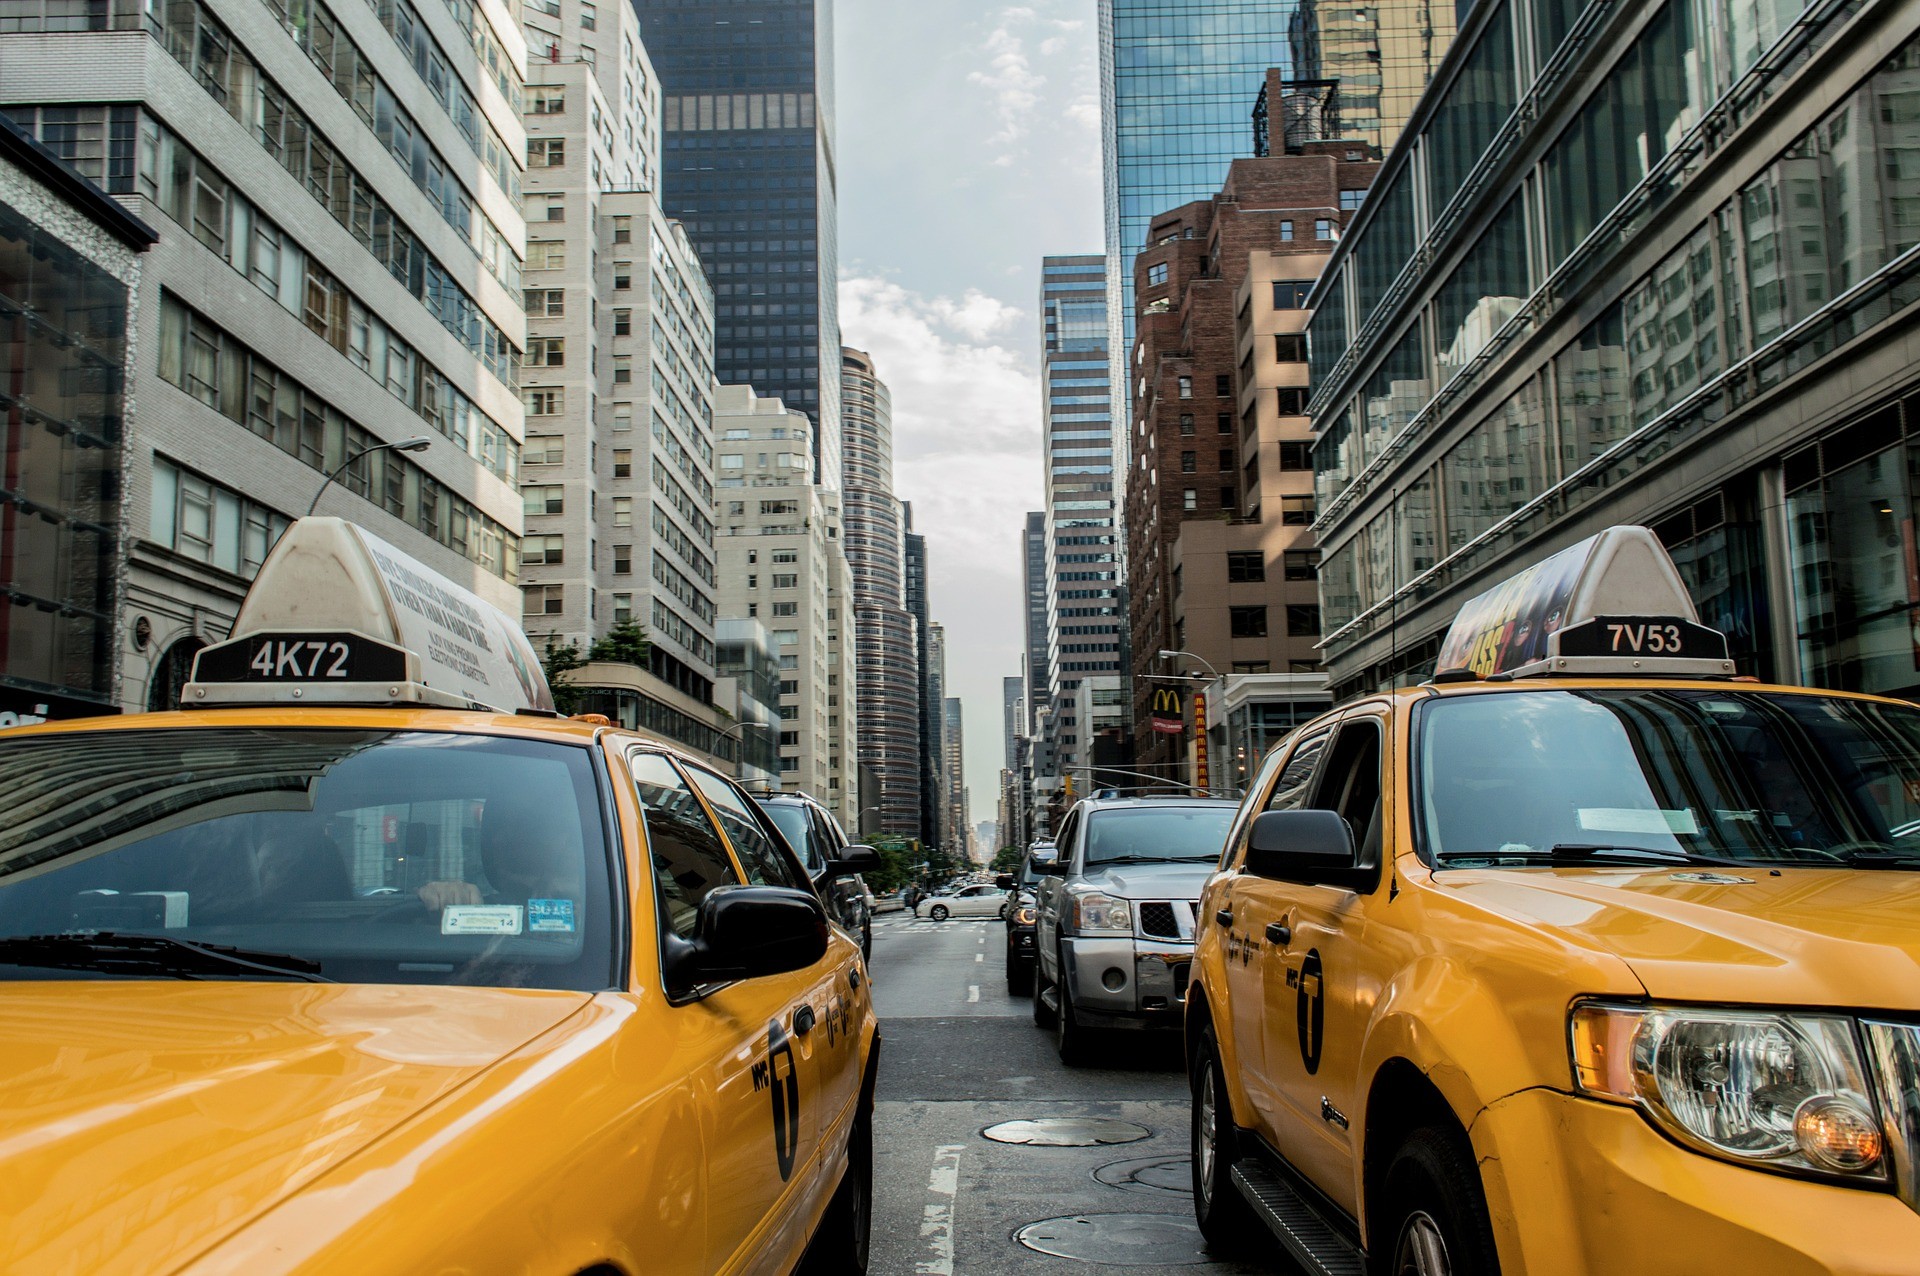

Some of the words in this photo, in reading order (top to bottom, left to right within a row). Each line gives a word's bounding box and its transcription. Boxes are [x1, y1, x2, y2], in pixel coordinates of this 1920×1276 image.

[389, 579, 424, 616] OTHER
[418, 596, 447, 628] THAN
[447, 612, 472, 643] HARD
[1607, 624, 1682, 653] 7V53
[251, 641, 349, 677] 4K72
[450, 918, 458, 927] 2
[500, 919, 513, 927] 14
[1286, 967, 1299, 990] NYC
[751, 1060, 769, 1092] NYC
